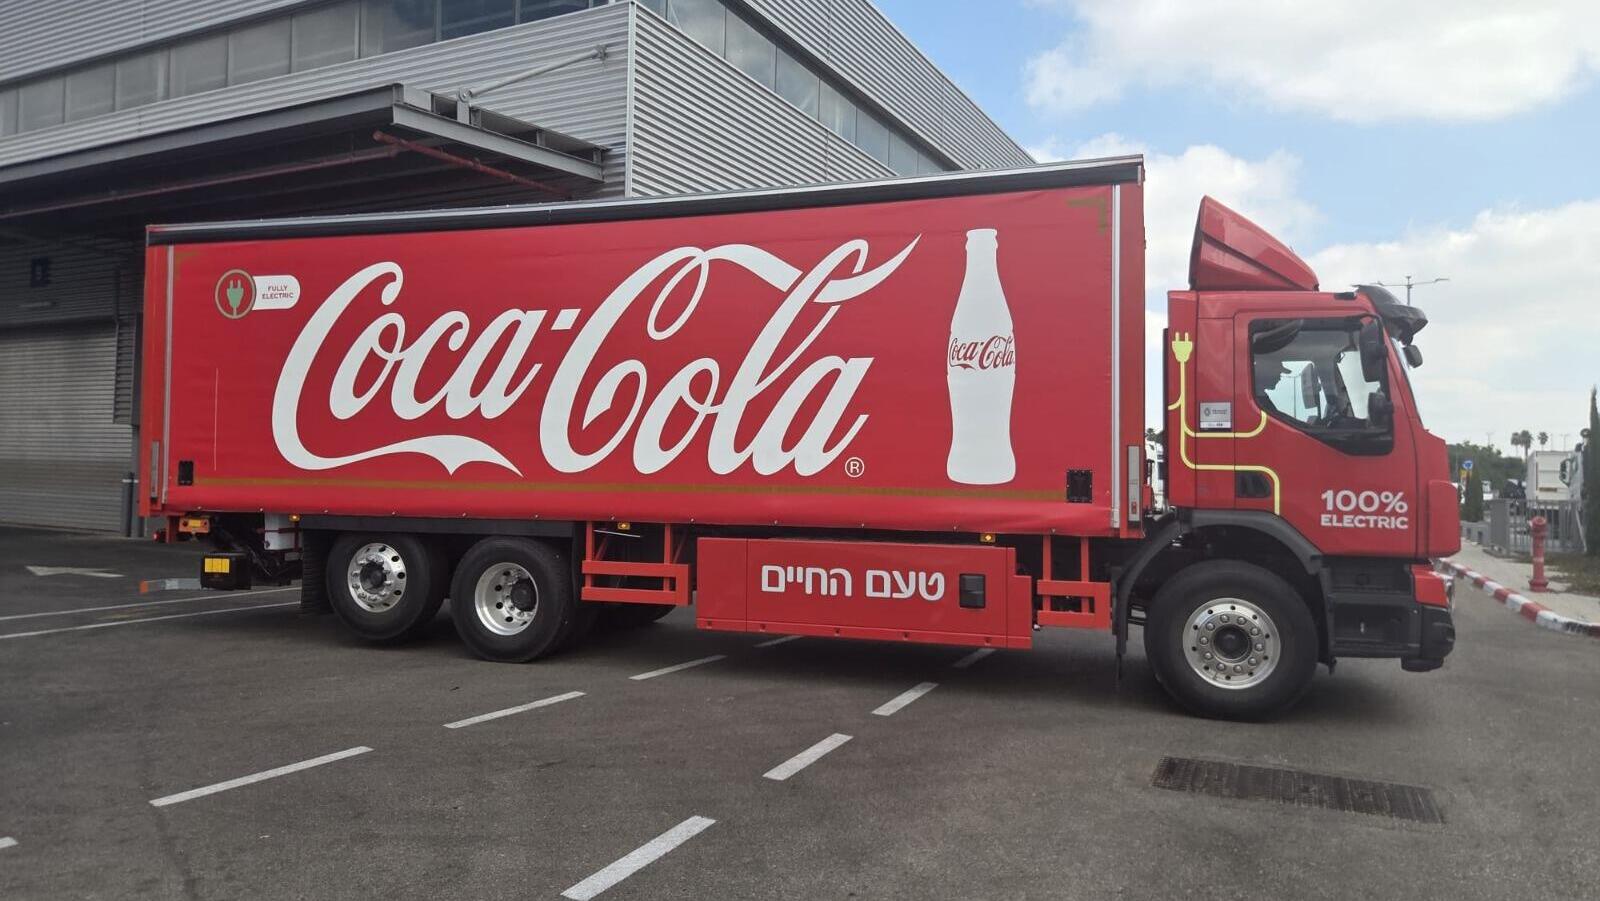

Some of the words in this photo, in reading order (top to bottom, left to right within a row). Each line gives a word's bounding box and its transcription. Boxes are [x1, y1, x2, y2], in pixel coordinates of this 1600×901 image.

[262, 292, 294, 300] ELECTRIC
[272, 233, 921, 477] Coca-Cola
[949, 335, 1014, 370] Coca-Cola
[1321, 489, 1408, 513] 100%
[1320, 513, 1408, 529] ELECTRIC
[761, 565, 852, 597] החיים
[865, 569, 945, 601] טעם
